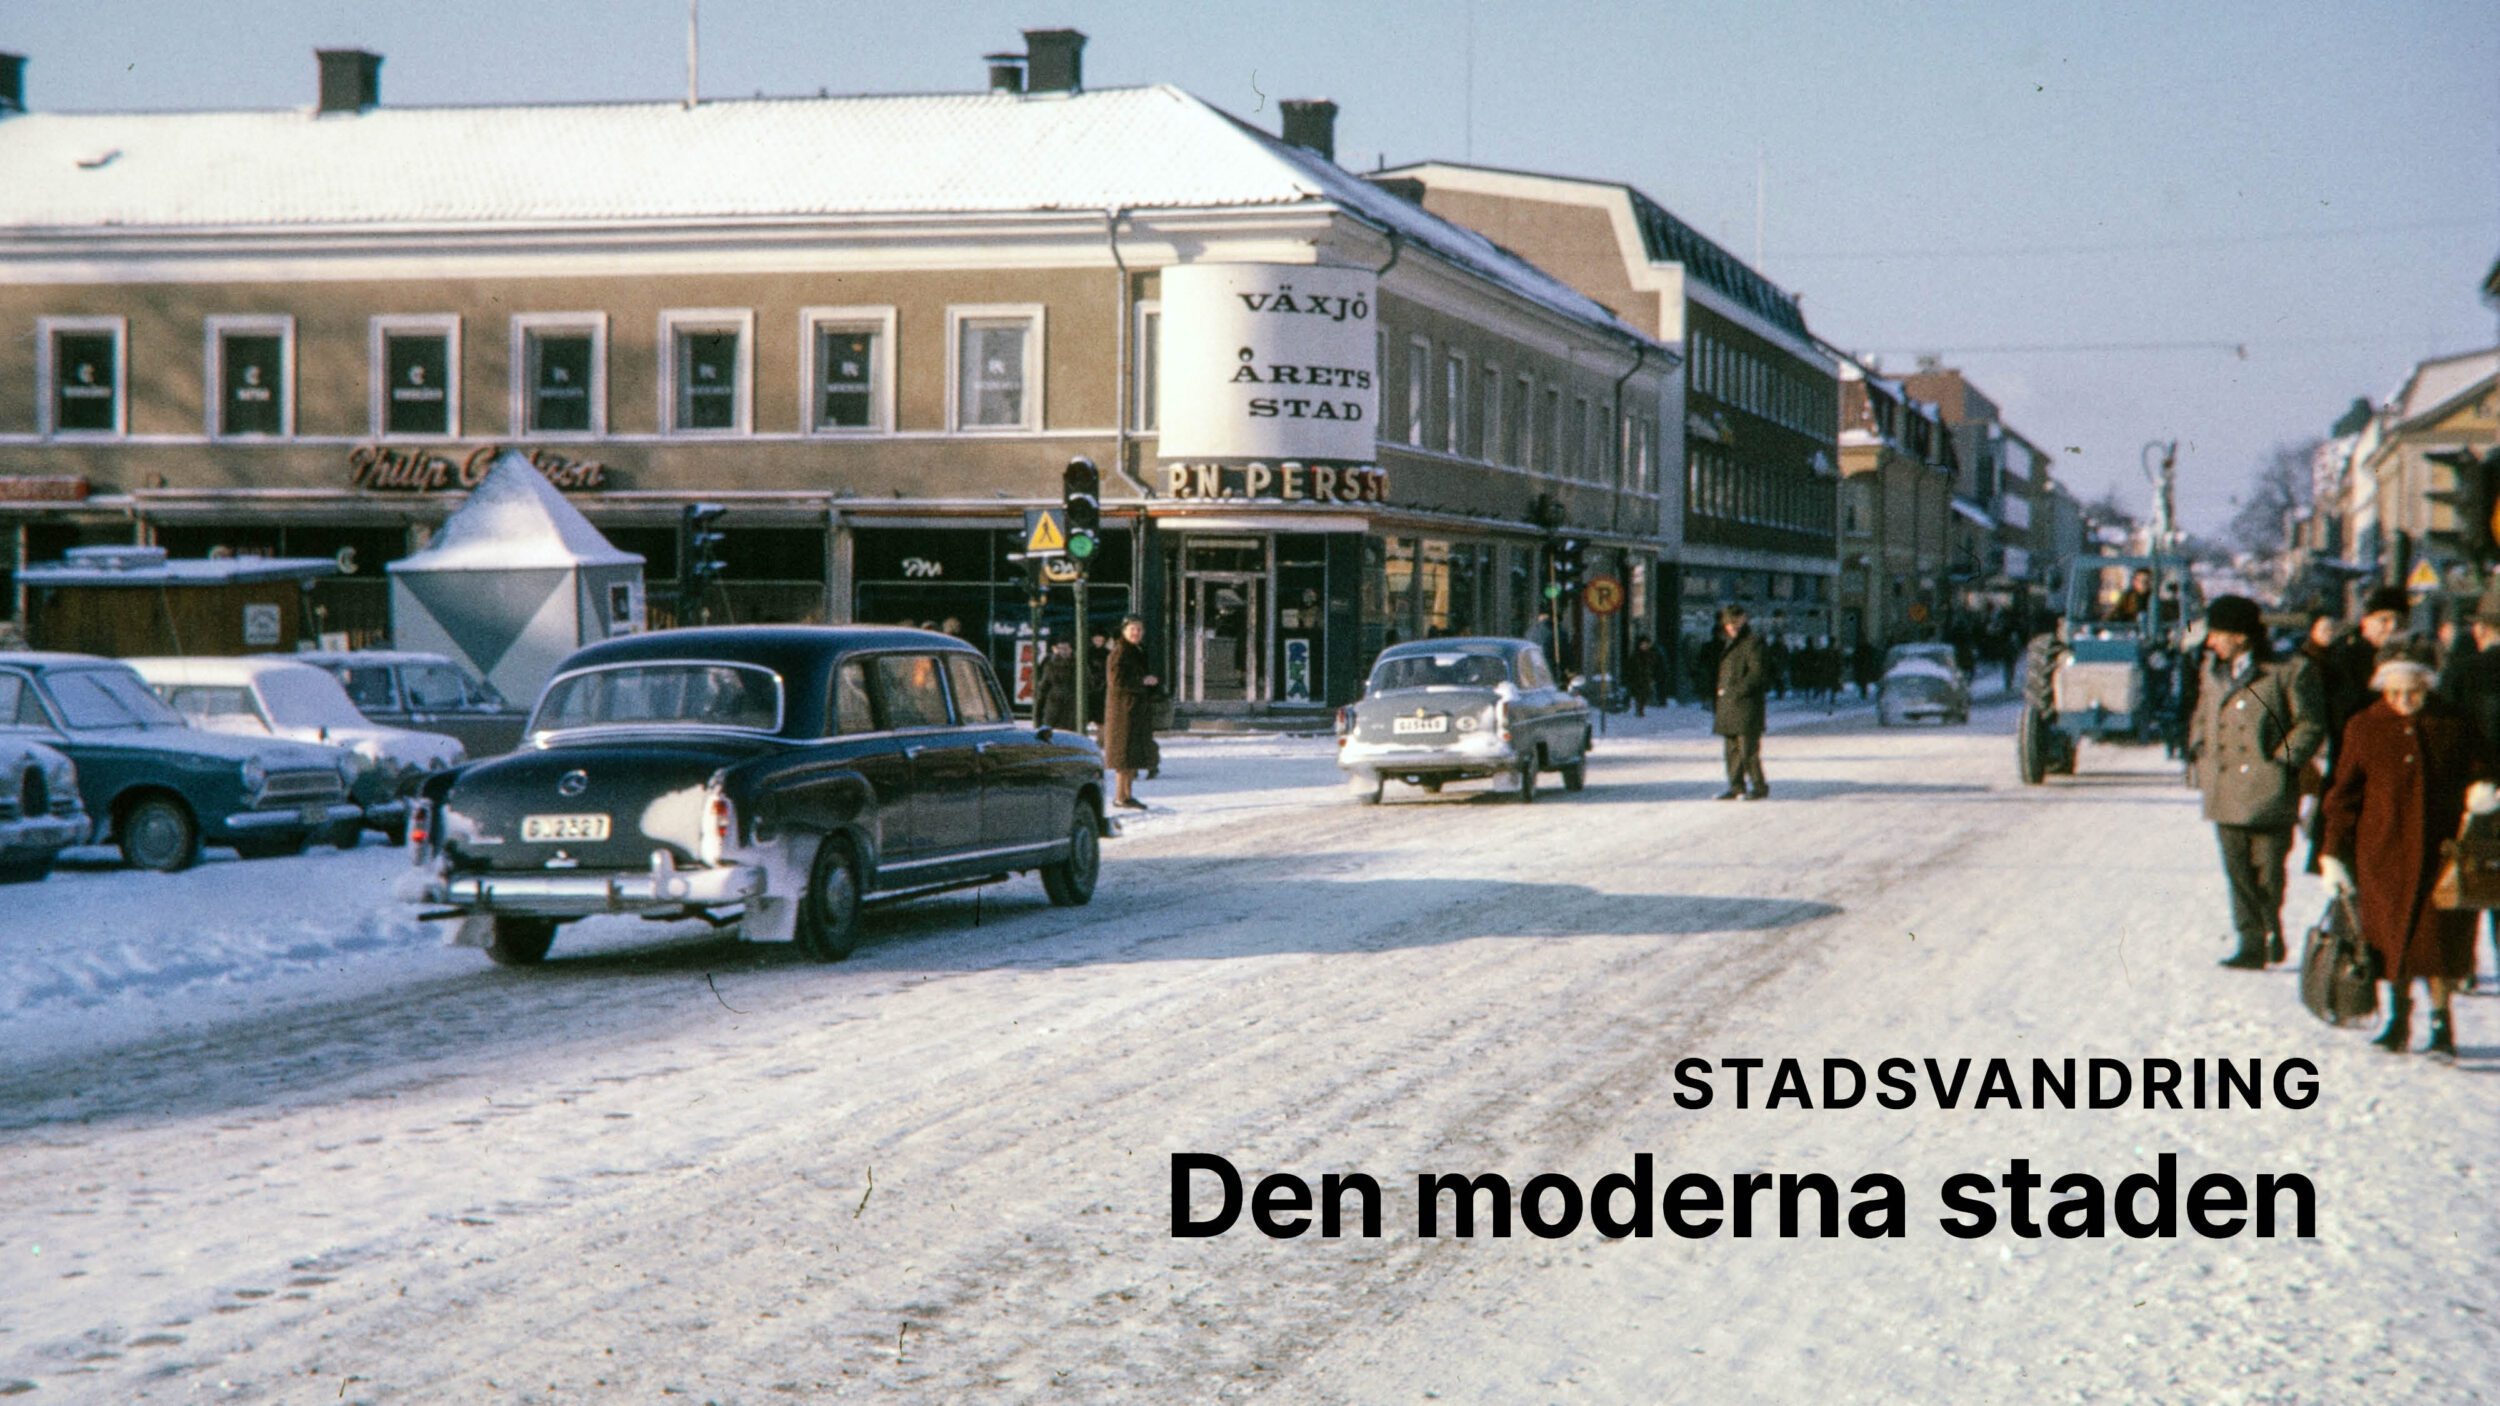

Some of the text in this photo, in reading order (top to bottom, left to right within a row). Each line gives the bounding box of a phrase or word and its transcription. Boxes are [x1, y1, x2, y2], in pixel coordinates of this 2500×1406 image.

[1237, 285, 1368, 322] VÄXJÖ
[1229, 346, 1371, 390] ÅRETS
[1249, 398, 1363, 421] STAD
[350, 445, 448, 491] Philip
[1168, 462, 1233, 499] P.N.
